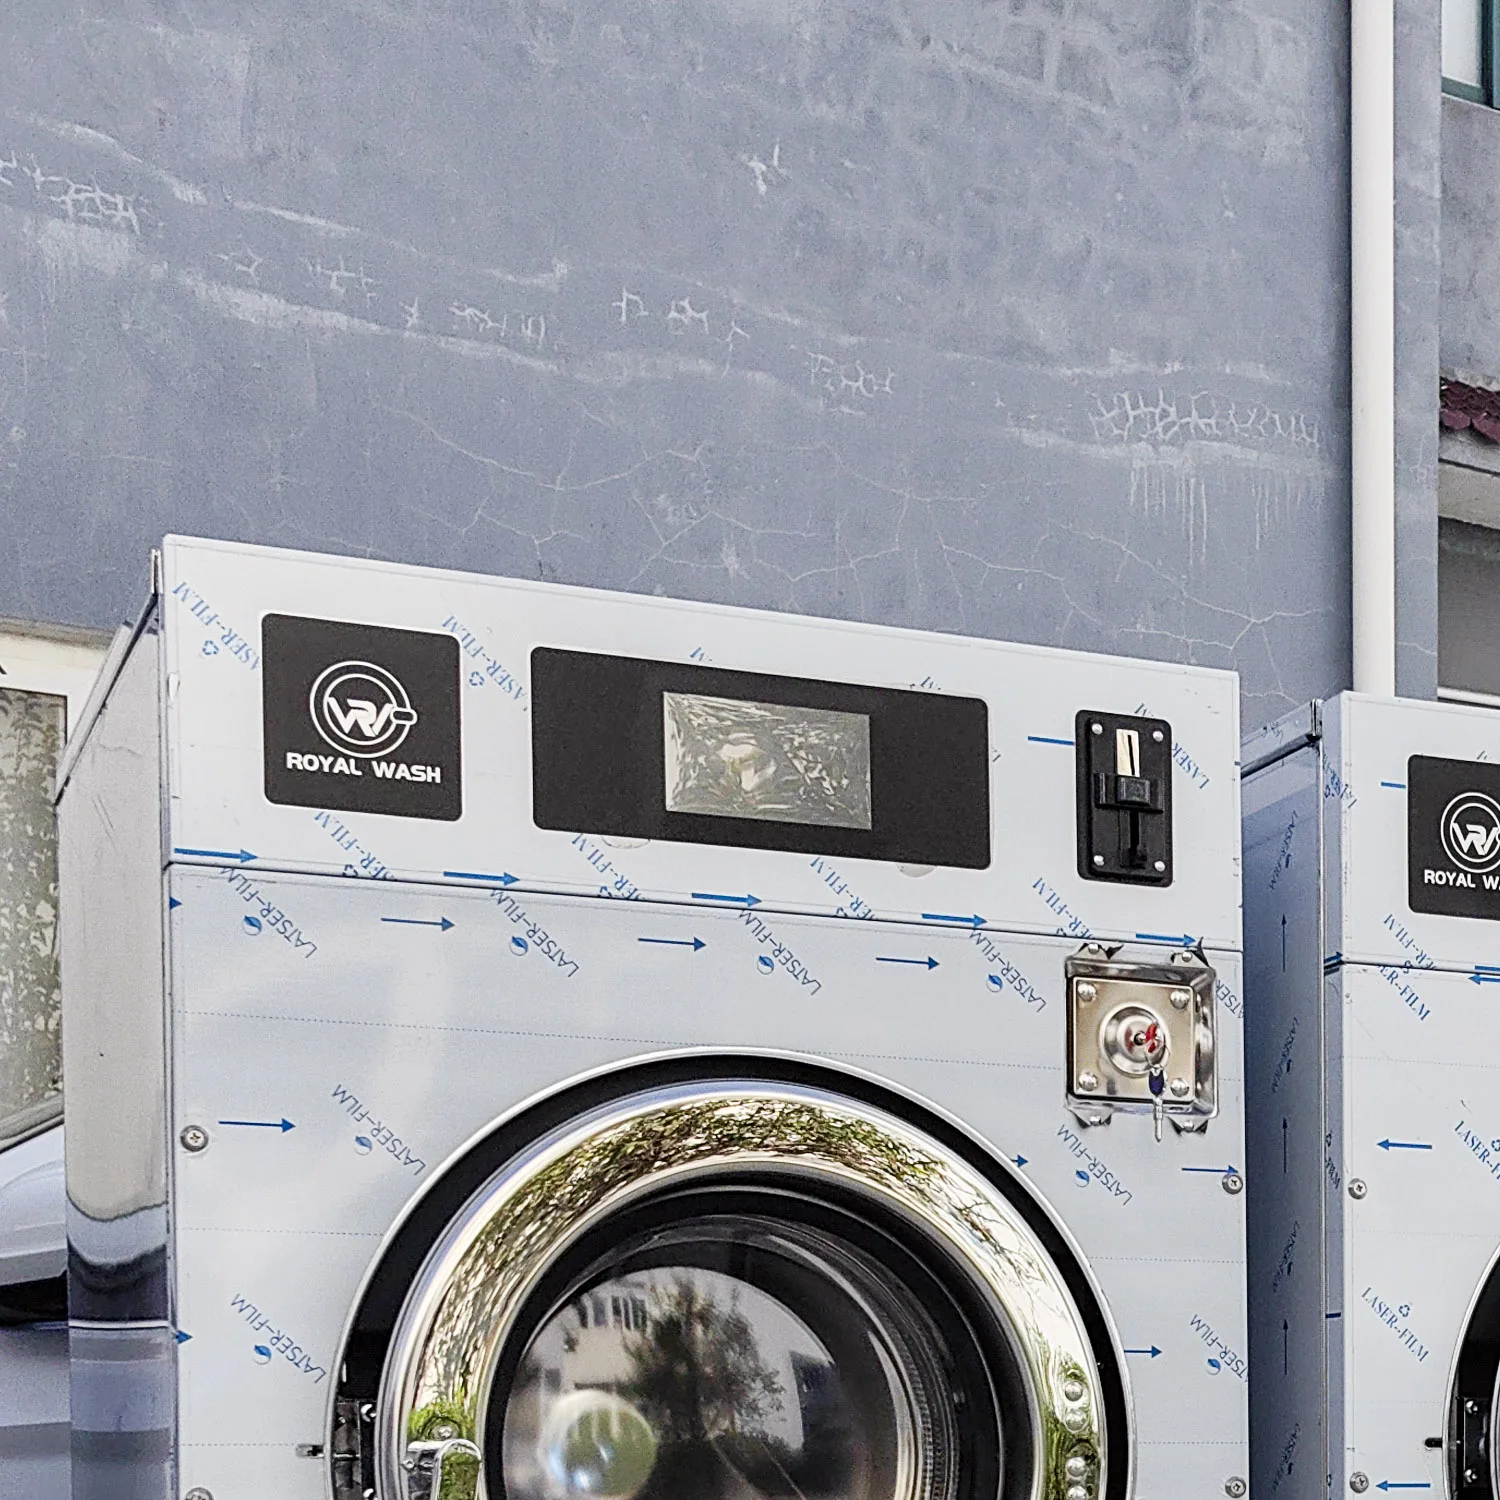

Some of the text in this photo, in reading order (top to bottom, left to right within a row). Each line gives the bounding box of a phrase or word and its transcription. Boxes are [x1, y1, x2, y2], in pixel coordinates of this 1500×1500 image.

[286, 752, 441, 783] ROYAL WASH
[1424, 870, 1475, 888] ROYAL
[1190, 1314, 1248, 1383] TSER-FILM
